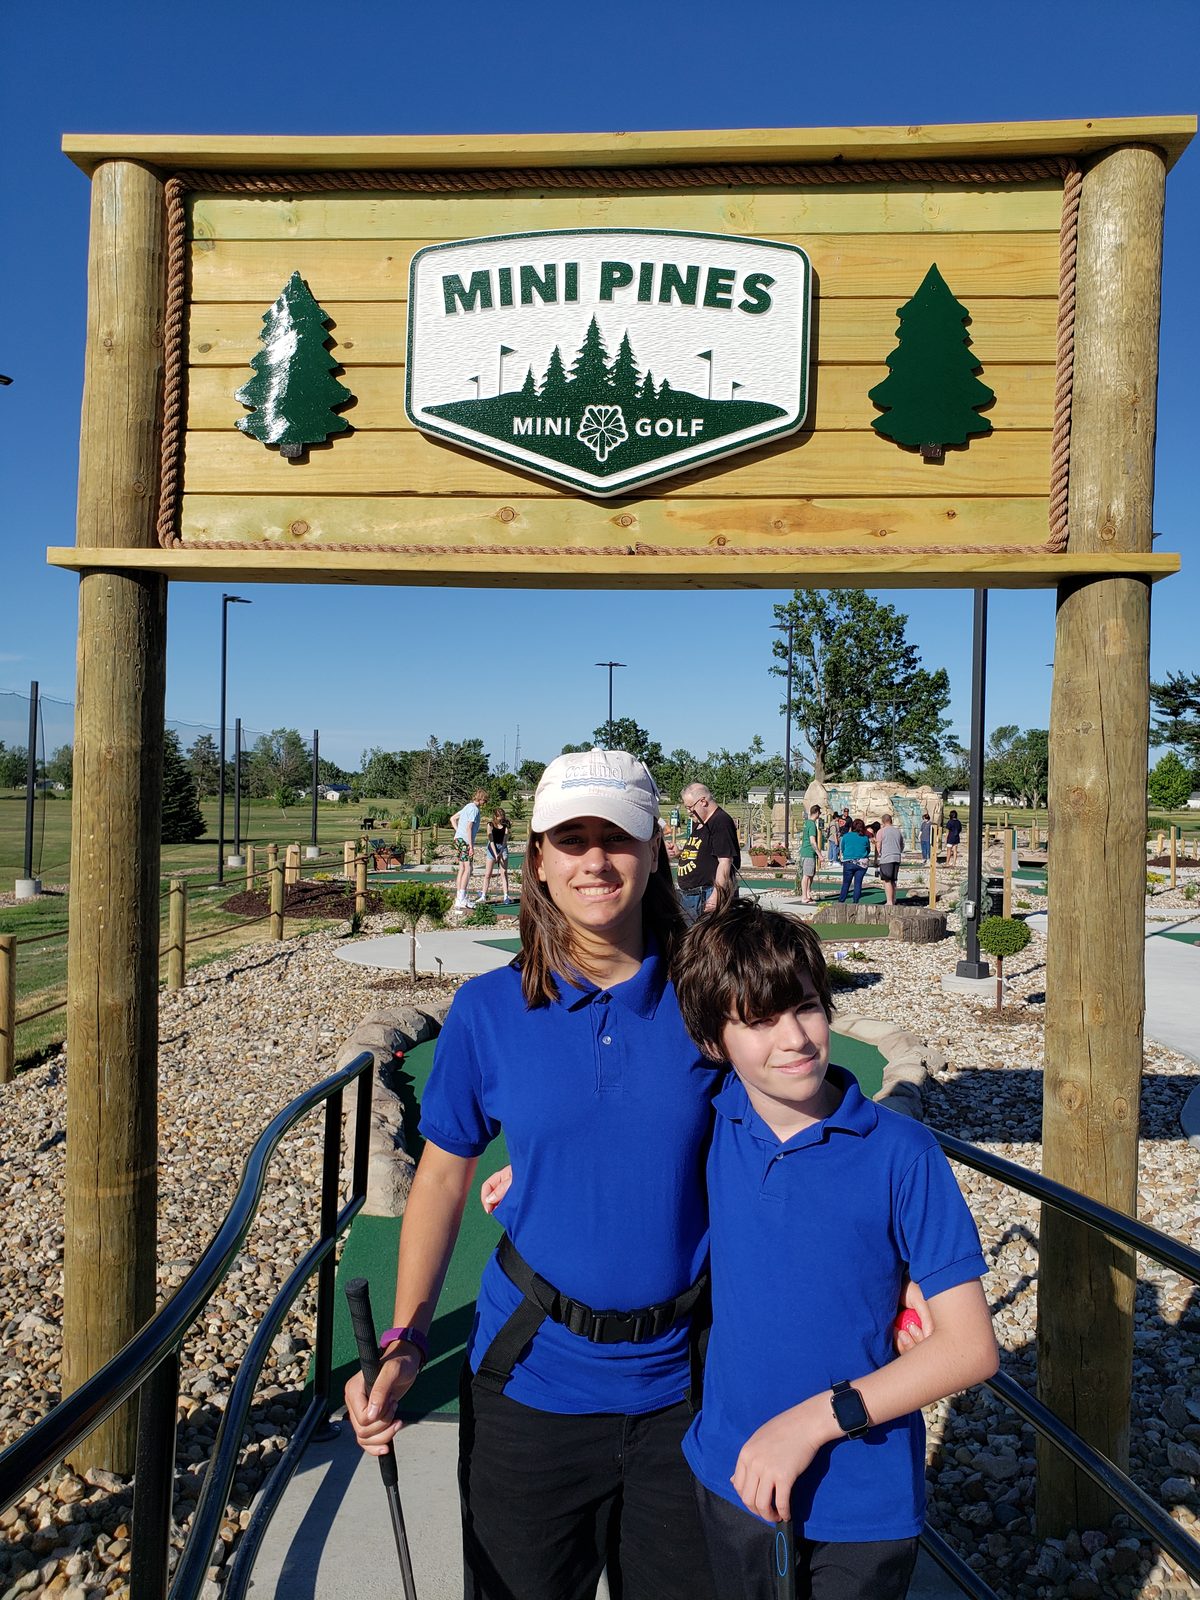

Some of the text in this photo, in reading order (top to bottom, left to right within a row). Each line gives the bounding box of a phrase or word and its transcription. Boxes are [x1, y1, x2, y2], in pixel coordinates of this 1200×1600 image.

[442, 260, 778, 316] MINI PINES
[512, 416, 705, 438] MINI GOLF
